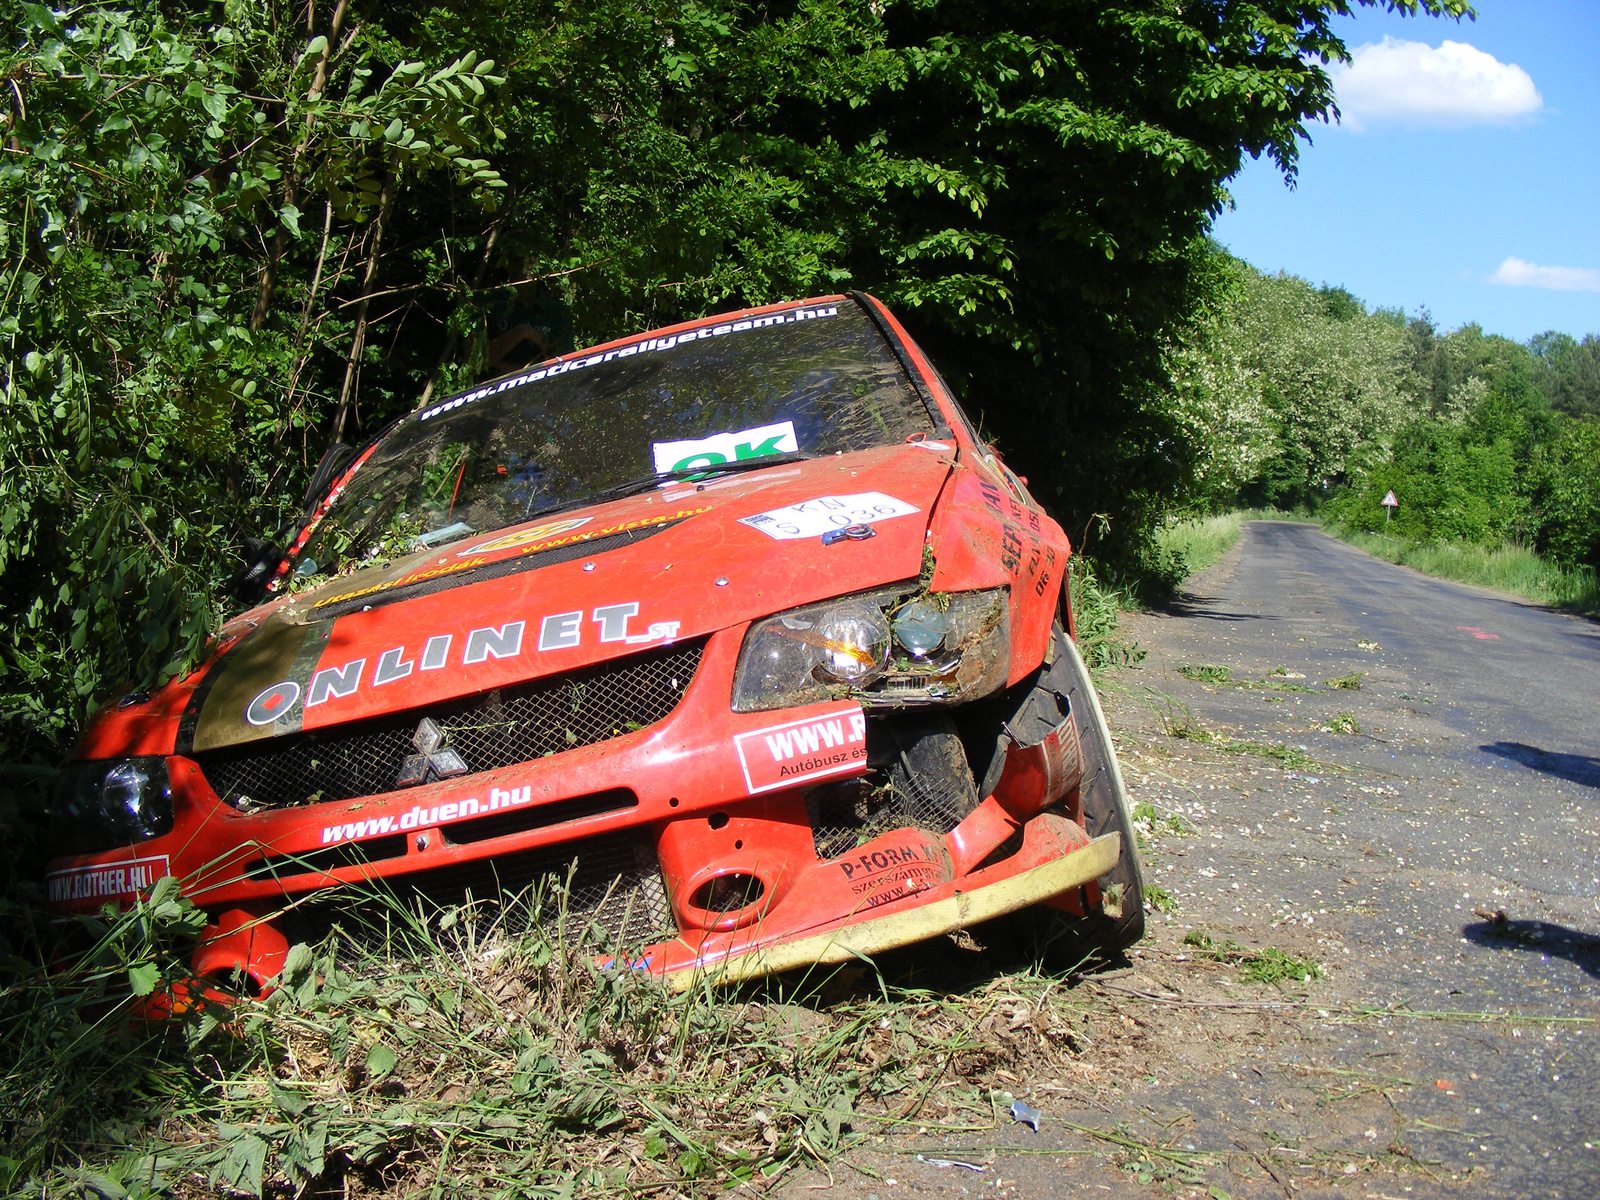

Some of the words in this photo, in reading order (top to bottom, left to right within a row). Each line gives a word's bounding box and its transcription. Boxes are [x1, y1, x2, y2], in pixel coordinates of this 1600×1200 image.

[420, 306, 838, 421] www.maticsrallyeteam.hu
[521, 504, 713, 555] www.vista.hu
[828, 504, 896, 526] 036
[780, 751, 848, 777] Autóbusz
[852, 747, 869, 758] és
[321, 785, 532, 844] www.duen.hu
[840, 846, 920, 879] P-FORM
